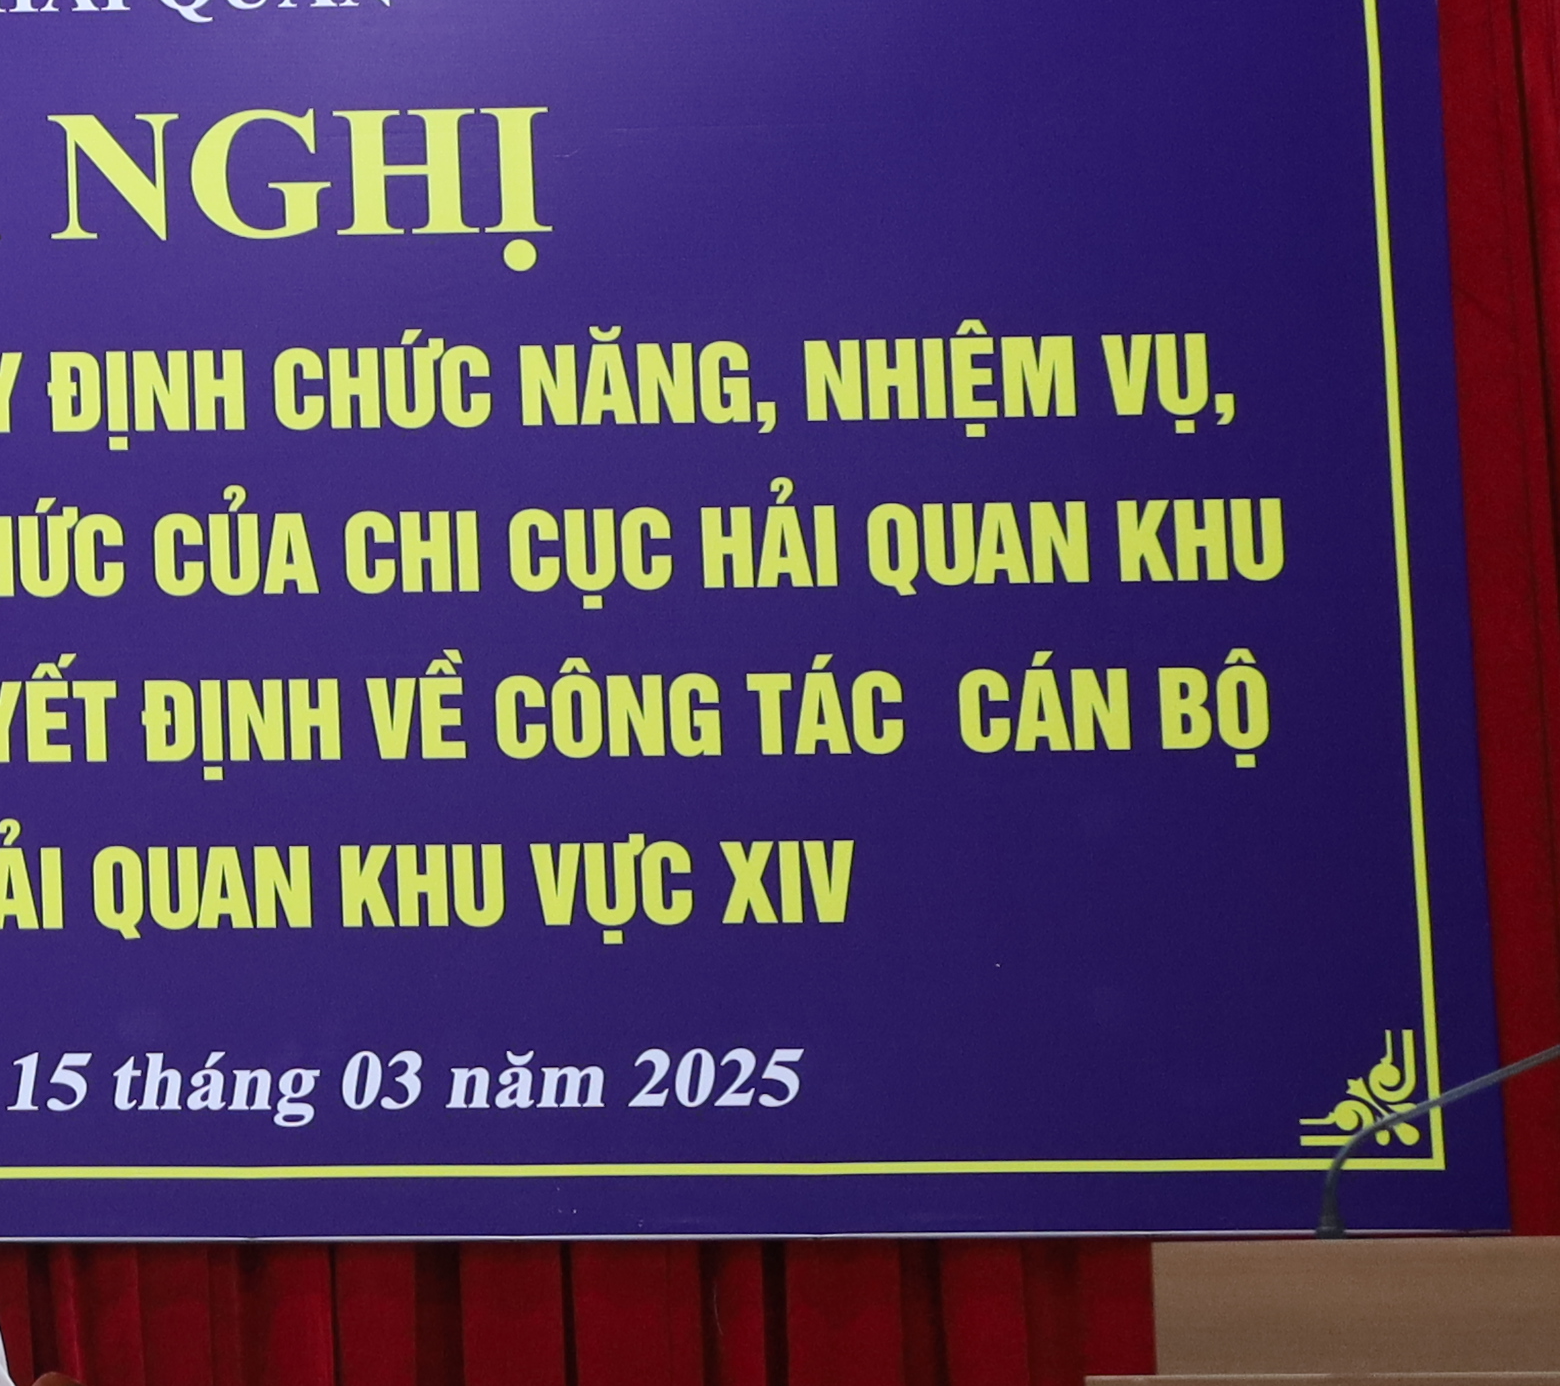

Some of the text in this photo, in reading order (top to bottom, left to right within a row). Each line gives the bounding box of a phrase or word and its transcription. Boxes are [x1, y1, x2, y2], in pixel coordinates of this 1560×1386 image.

[47, 106, 553, 272] NGHỊ
[47, 349, 245, 451] ĐỊNH
[273, 328, 491, 431] CHỨC
[519, 325, 776, 434] NĂNG,
[803, 319, 1076, 438] NHIỆM
[1101, 333, 1235, 434] VỤ,
[154, 485, 319, 597] CỦA
[344, 510, 480, 594] CHI
[509, 507, 672, 609] CỤC
[700, 477, 838, 589] HẢI
[867, 501, 1090, 596] QUAN
[1117, 498, 1284, 582] KHU
[141, 678, 341, 781] ĐỊNH
[365, 649, 467, 760] VỀ
[495, 657, 722, 759] CÔNG
[746, 654, 904, 755] TÁC
[958, 651, 1131, 753] CÁN
[1158, 648, 1269, 768] BỘ
[93, 845, 312, 940] QUAN
[340, 843, 504, 927] KHU
[529, 833, 693, 945] VỰC
[719, 840, 854, 924] XIV
[7, 1052, 92, 1111] 15
[113, 1051, 321, 1127] tháng
[342, 1050, 422, 1110] 03
[445, 1050, 605, 1109] năm
[628, 1048, 804, 1108] 2025
